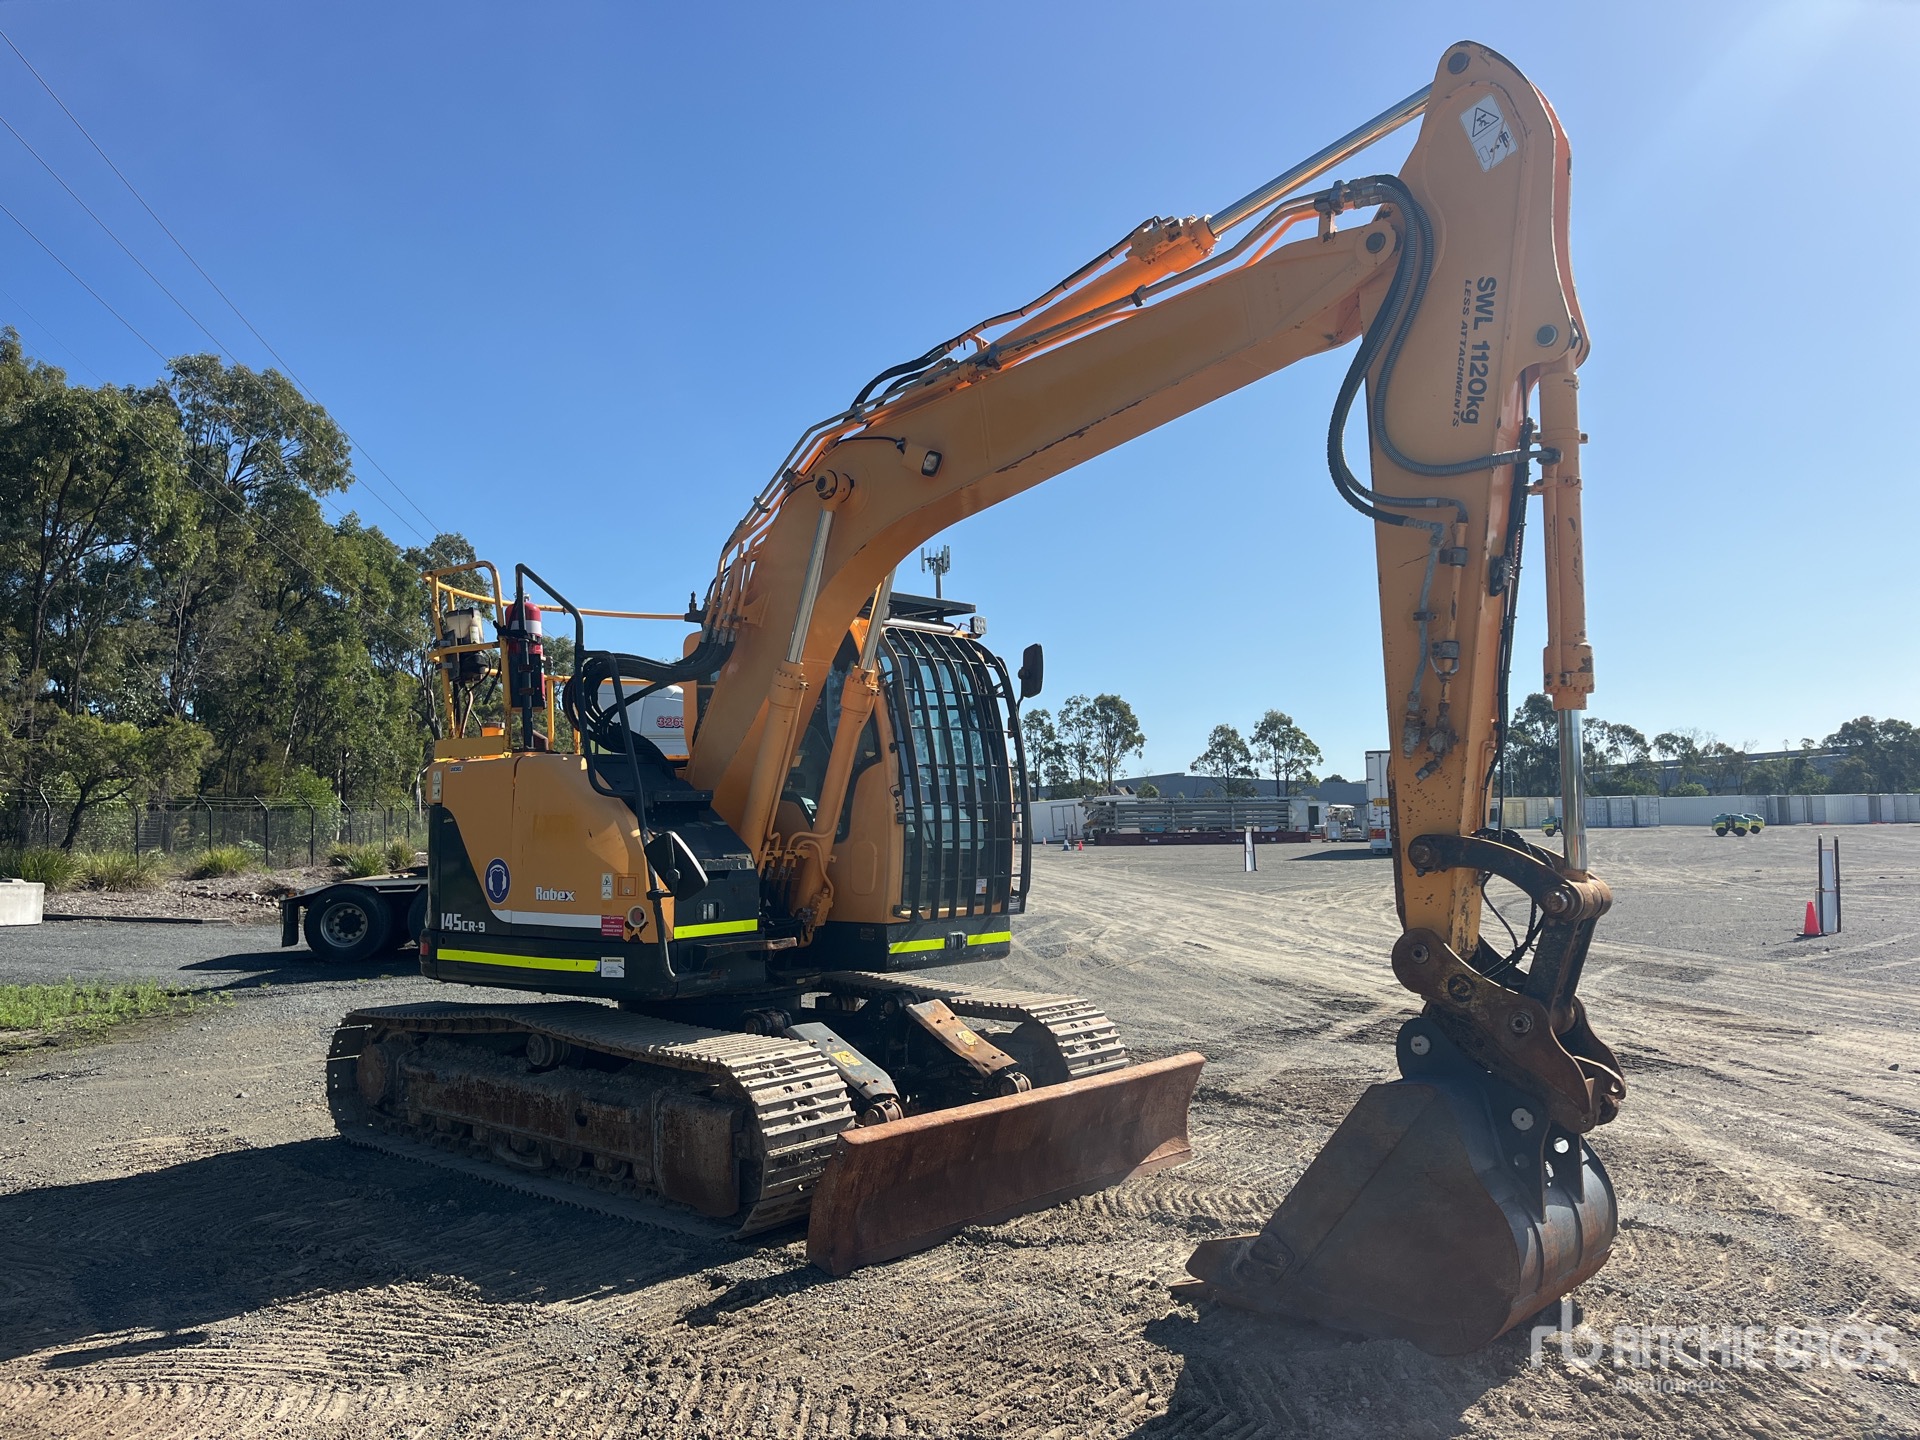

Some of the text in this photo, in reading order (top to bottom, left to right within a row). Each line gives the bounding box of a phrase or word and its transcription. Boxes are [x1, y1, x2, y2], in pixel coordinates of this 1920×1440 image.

[1452, 279, 1472, 427] LESS ATTACHMENTS
[1461, 276, 1497, 424] SWL 1120kg
[441, 913, 486, 932] 145CR-9
[535, 886, 576, 902] Robex
